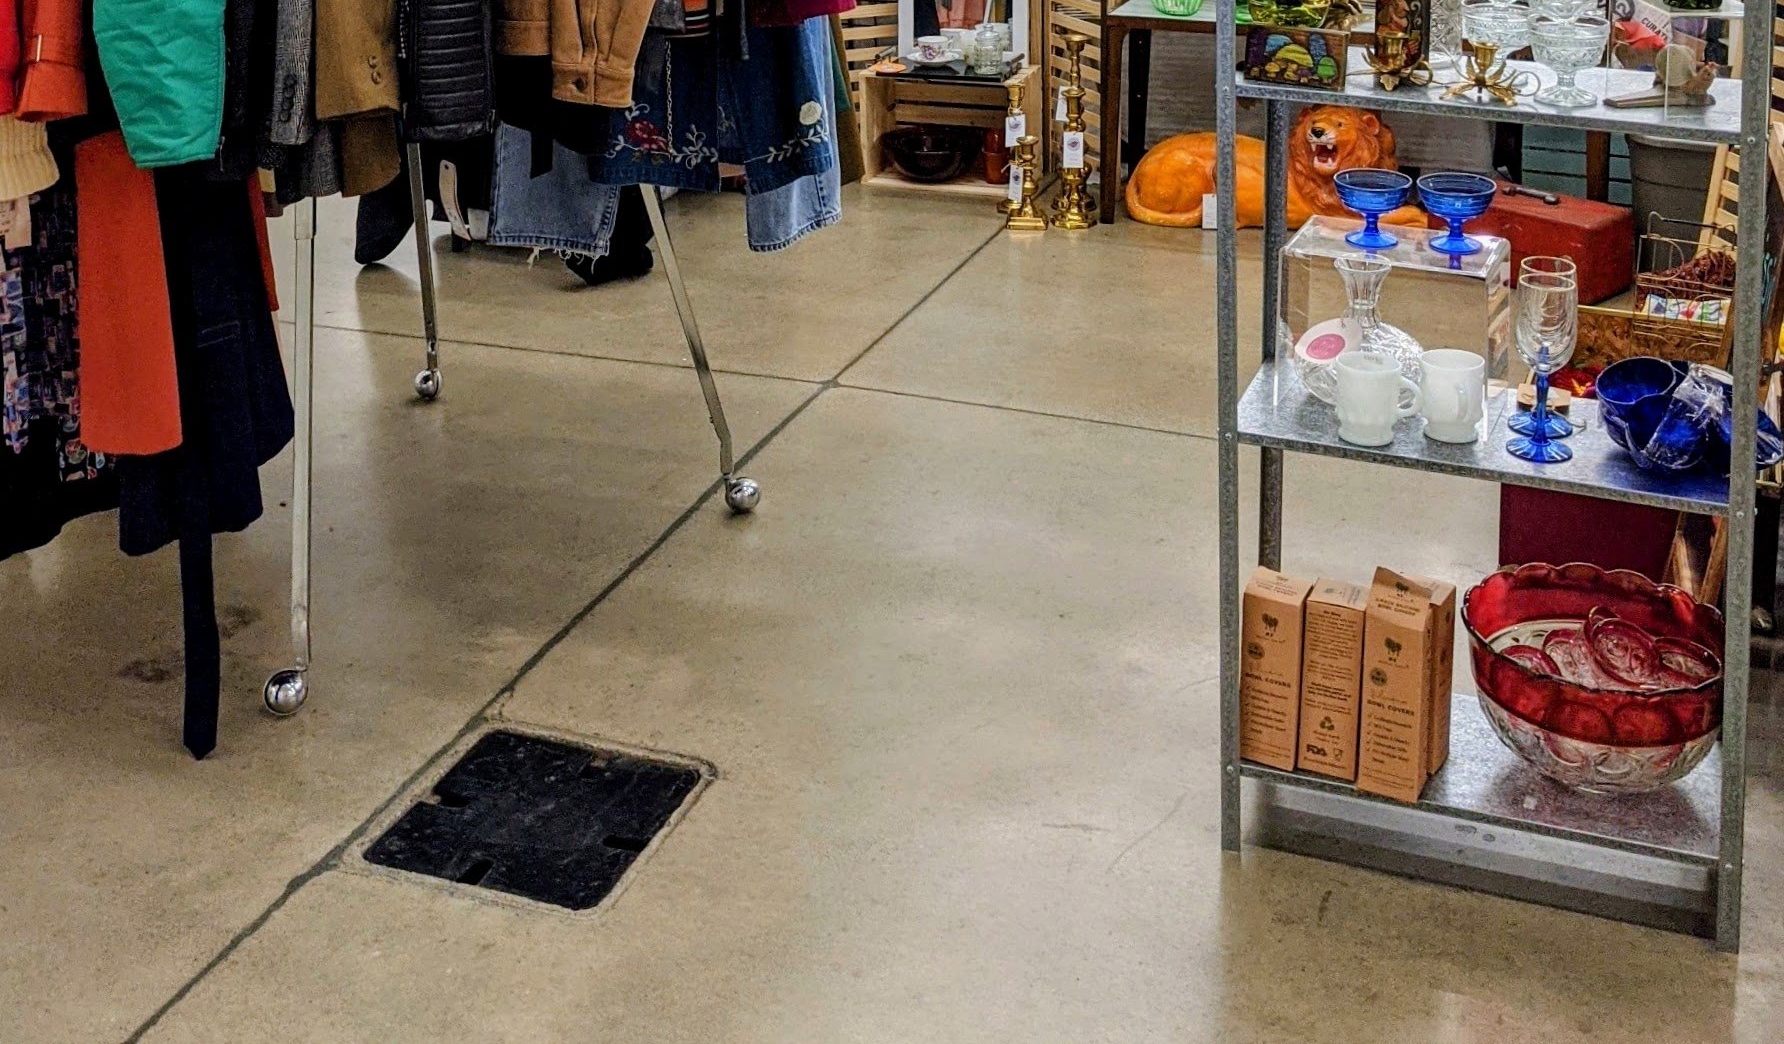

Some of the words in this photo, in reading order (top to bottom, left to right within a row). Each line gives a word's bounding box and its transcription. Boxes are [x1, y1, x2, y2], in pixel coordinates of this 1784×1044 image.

[1641, 17, 1668, 42] CURAT
[1387, 704, 1415, 716] COVERS
[1306, 744, 1328, 757] FDA
